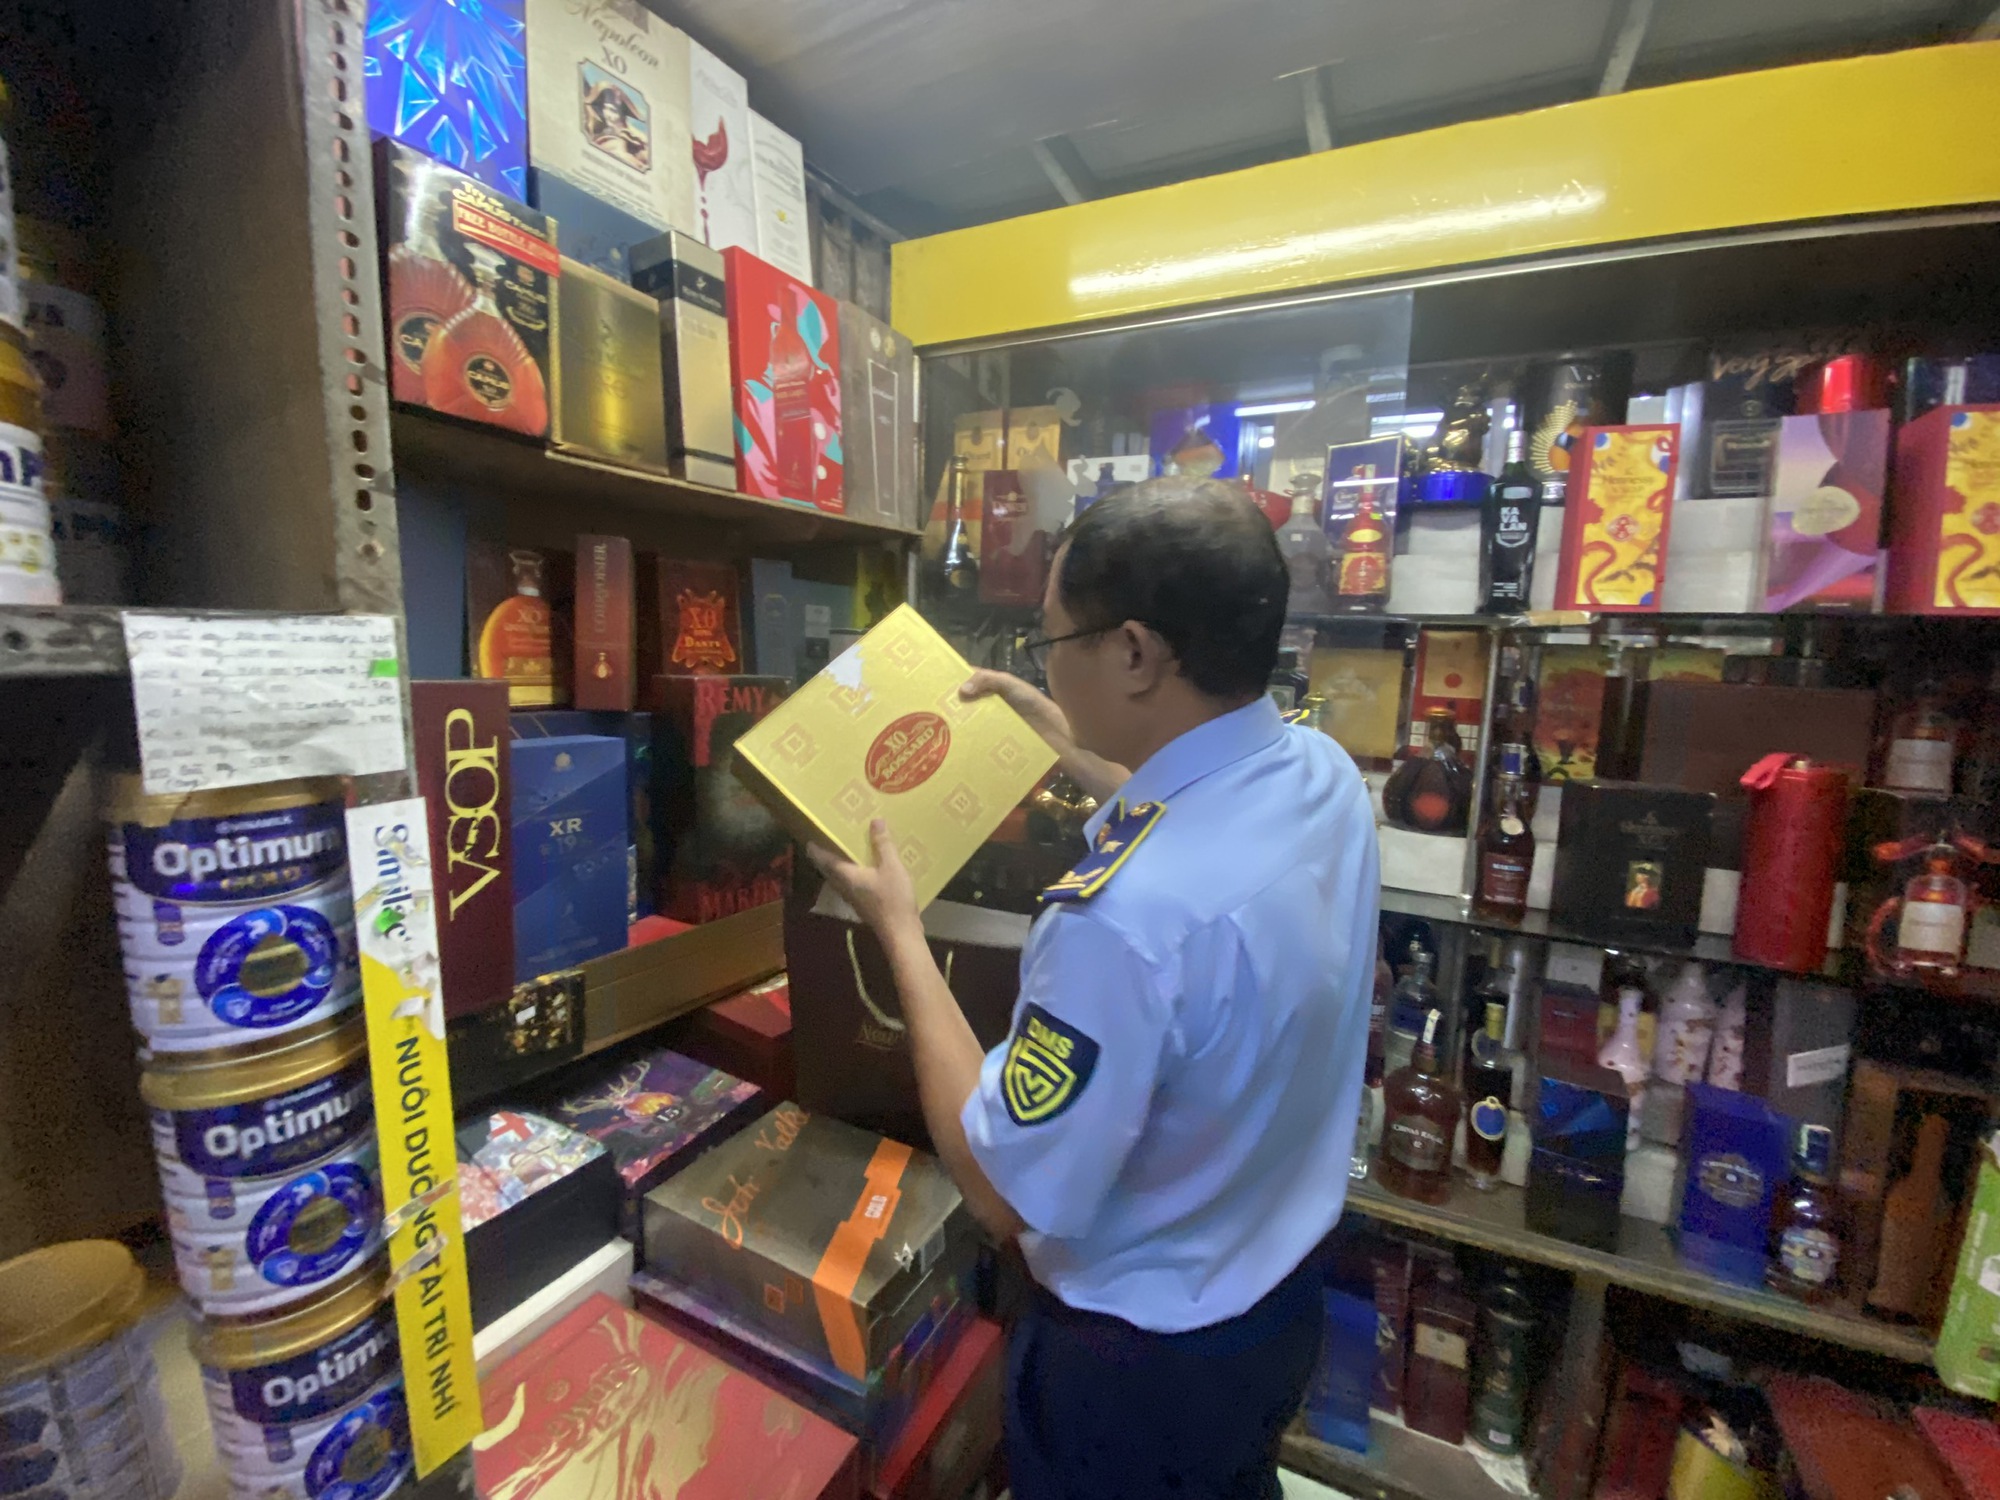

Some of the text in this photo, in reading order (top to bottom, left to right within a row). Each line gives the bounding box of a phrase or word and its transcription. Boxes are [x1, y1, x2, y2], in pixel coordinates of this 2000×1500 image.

[601, 46, 627, 74] XO
[1501, 506, 1520, 516] KA
[1500, 522, 1527, 532] LAN
[690, 607, 717, 629] XO
[881, 726, 934, 780] BOSSARD
[884, 730, 908, 754] XO
[445, 708, 501, 922] VSOP
[549, 817, 583, 837] XR
[395, 1036, 430, 1124] NUÔI
[203, 1092, 356, 1158] Optimu
[262, 1332, 388, 1407] Optim
